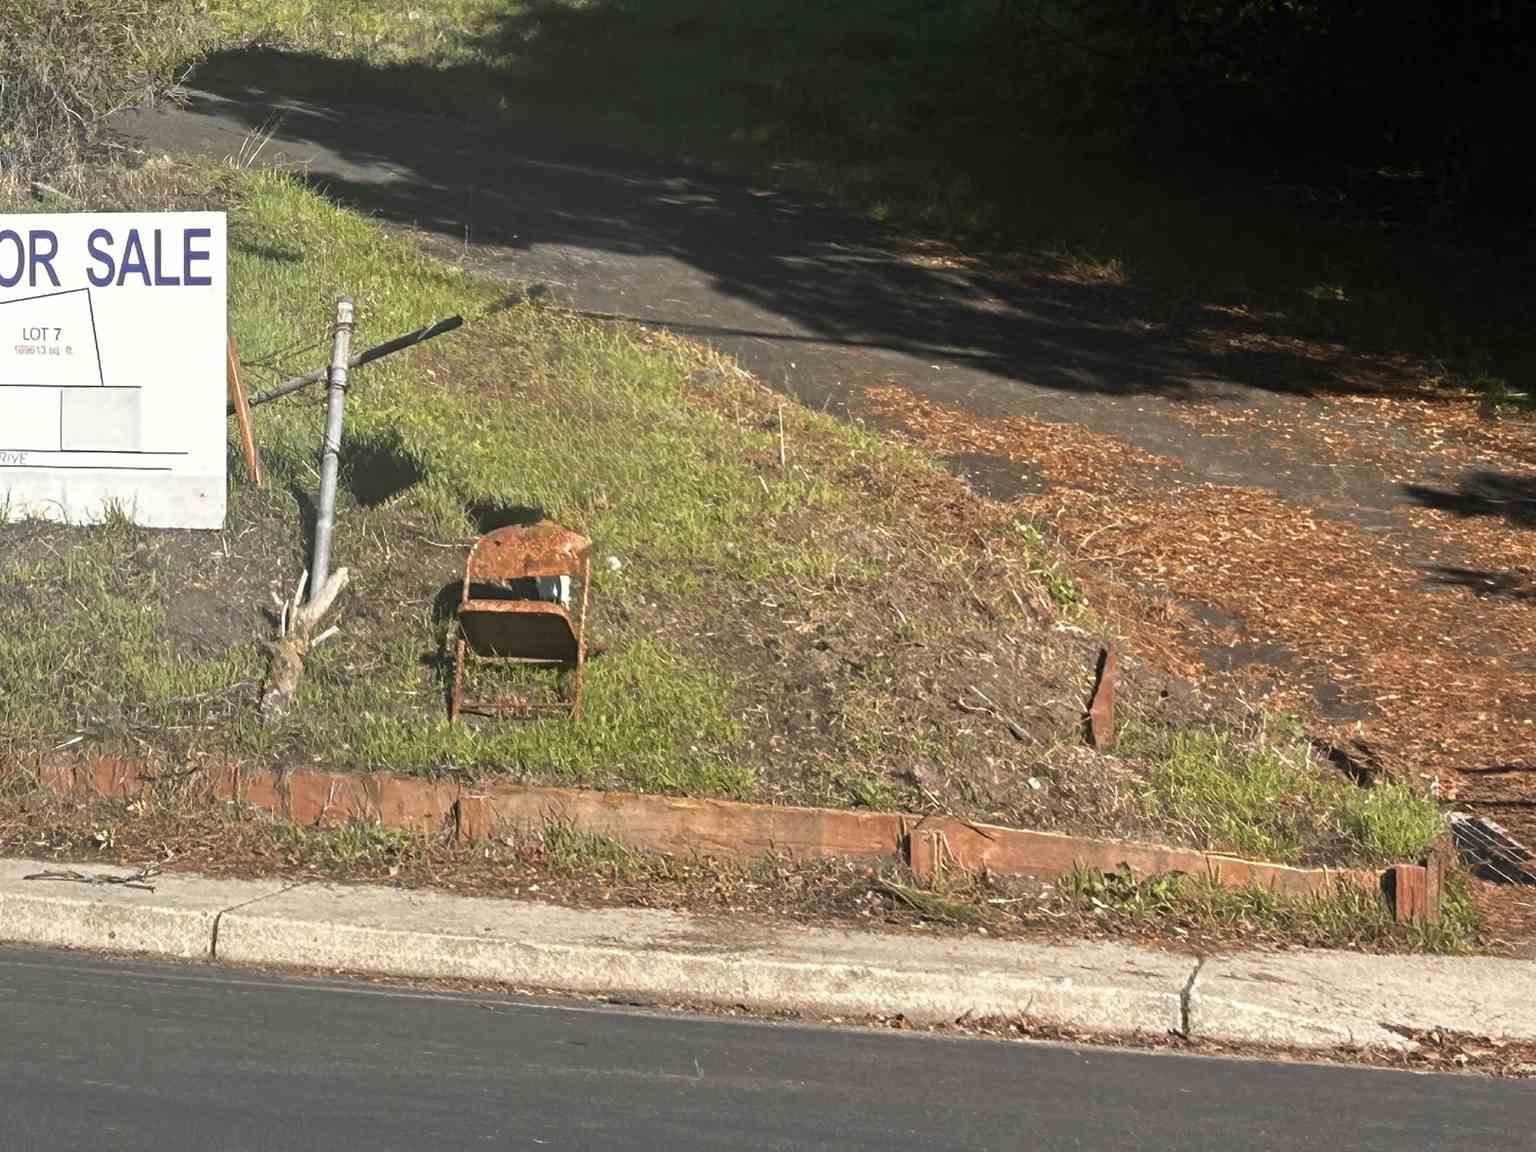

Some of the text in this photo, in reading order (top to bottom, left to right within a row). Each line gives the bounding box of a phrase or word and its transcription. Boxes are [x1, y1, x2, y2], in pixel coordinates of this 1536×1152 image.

[86, 227, 213, 288] SALE
[22, 327, 62, 341] LOT 7
